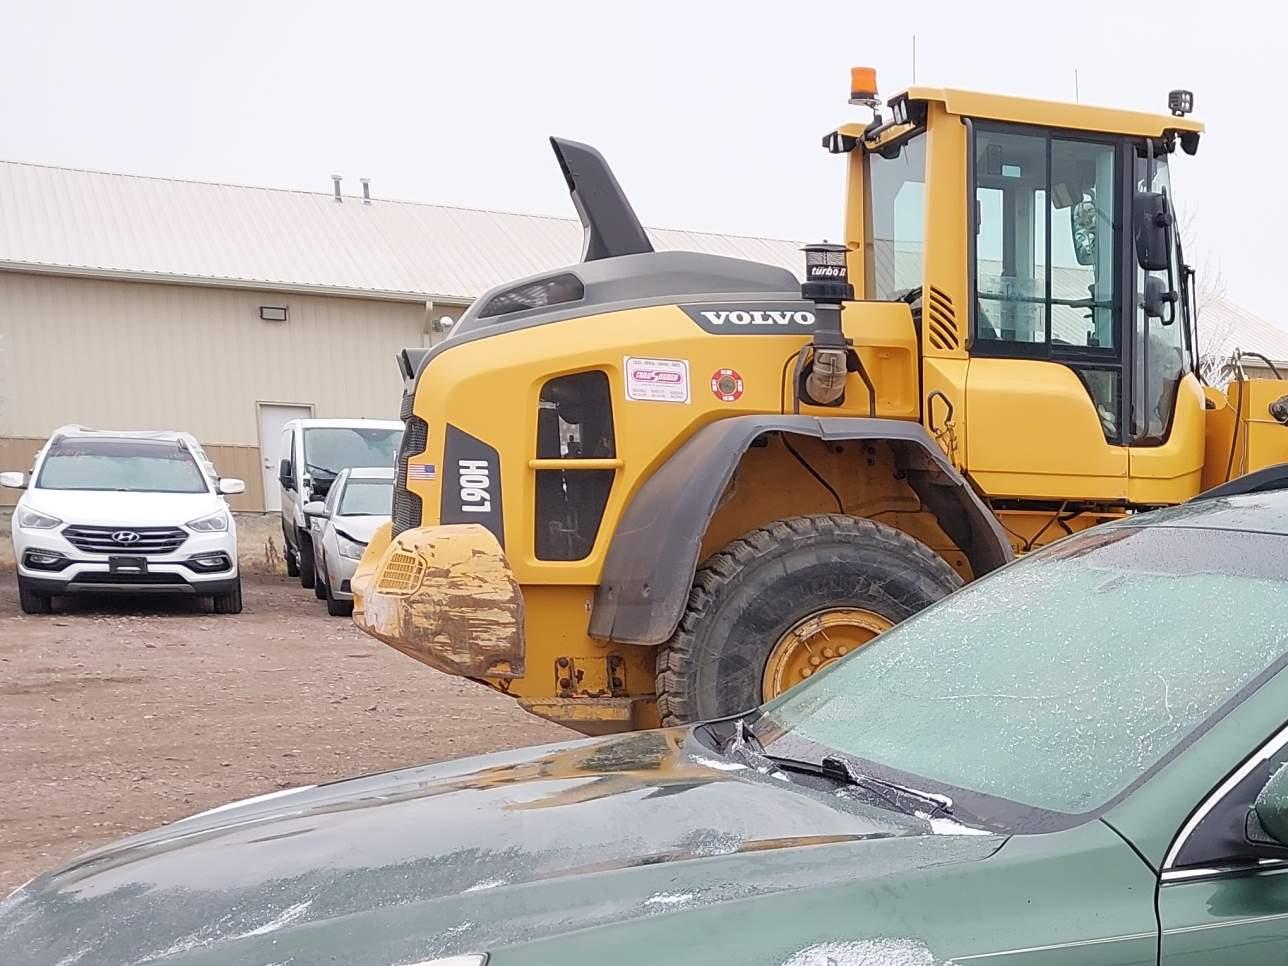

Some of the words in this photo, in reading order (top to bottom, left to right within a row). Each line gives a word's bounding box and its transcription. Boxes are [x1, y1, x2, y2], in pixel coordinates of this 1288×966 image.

[811, 266, 839, 277] turbo
[701, 311, 815, 325] VOLVO
[459, 459, 491, 512] L90H
